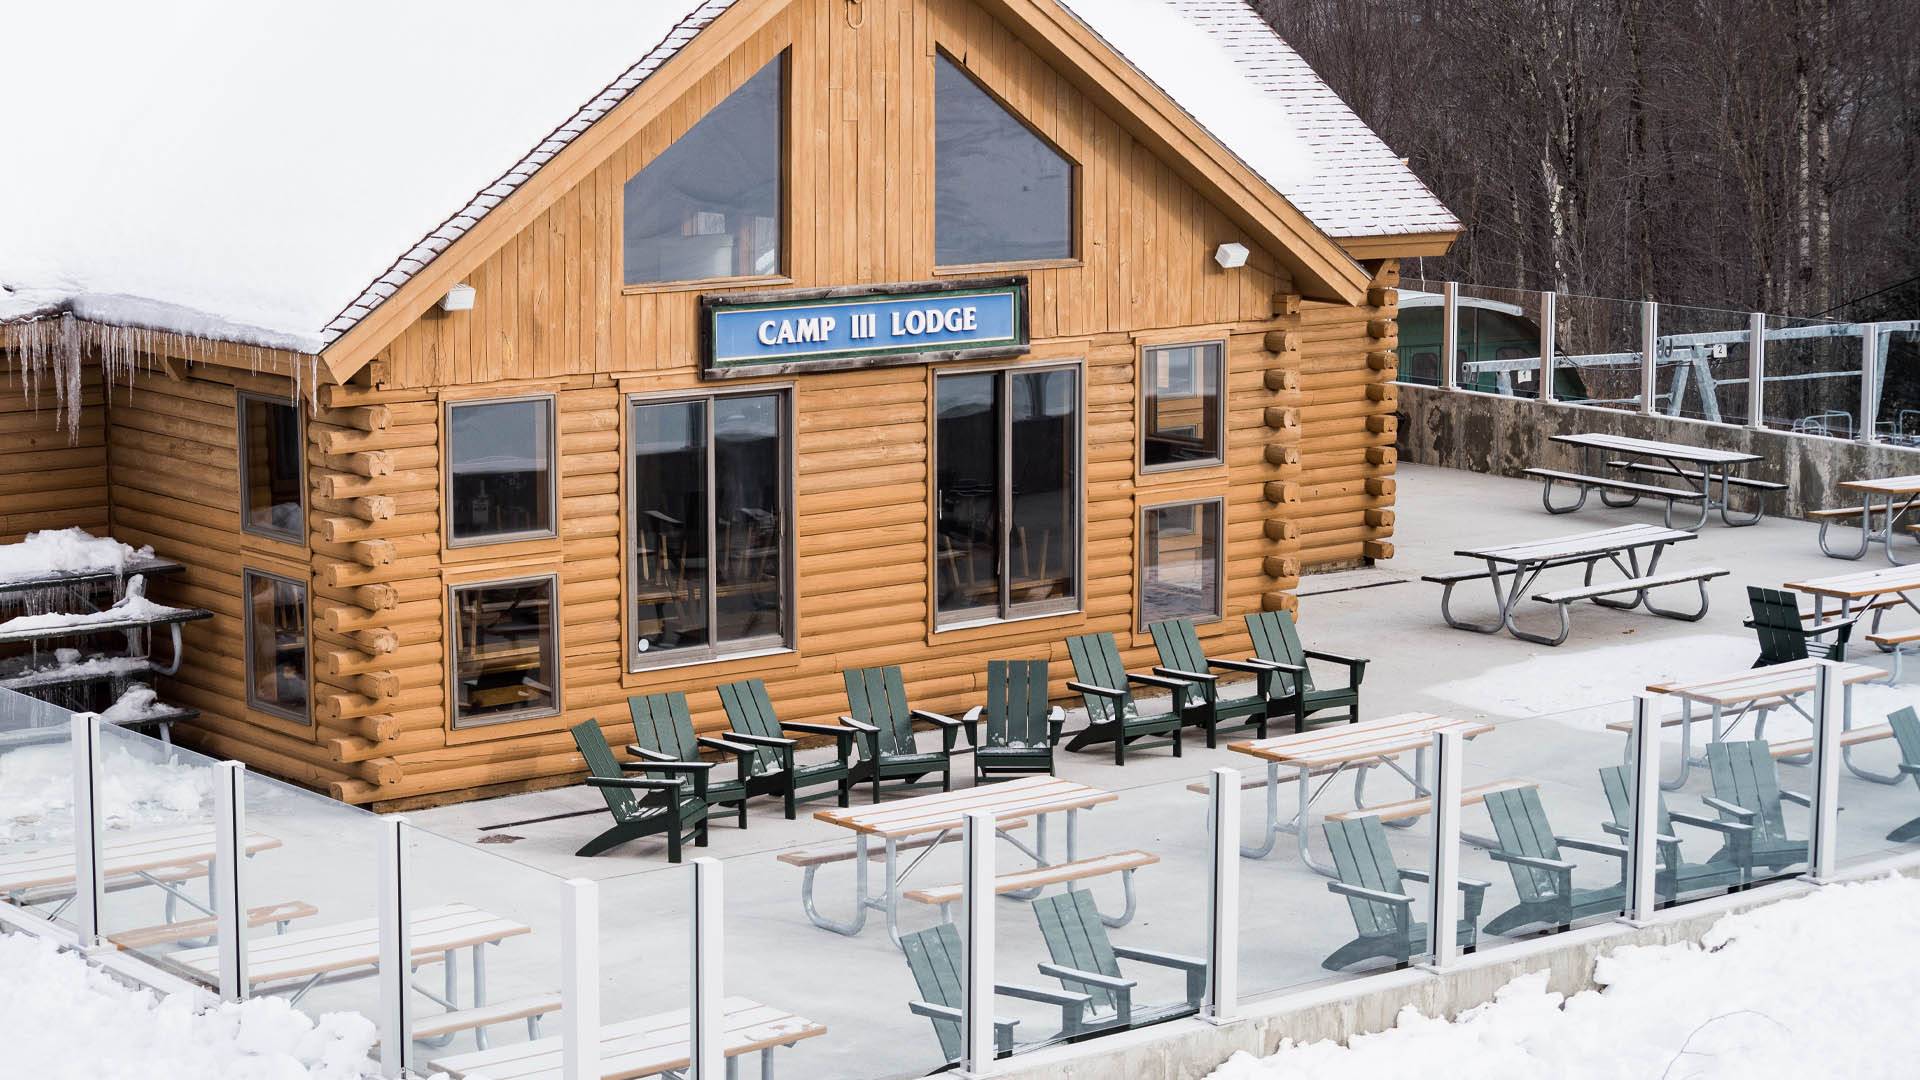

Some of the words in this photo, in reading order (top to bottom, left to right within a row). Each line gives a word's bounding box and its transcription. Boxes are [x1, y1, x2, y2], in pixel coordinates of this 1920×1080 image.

[758, 317, 836, 346] CAMP
[851, 313, 876, 339] III
[891, 306, 978, 336] LODGE
